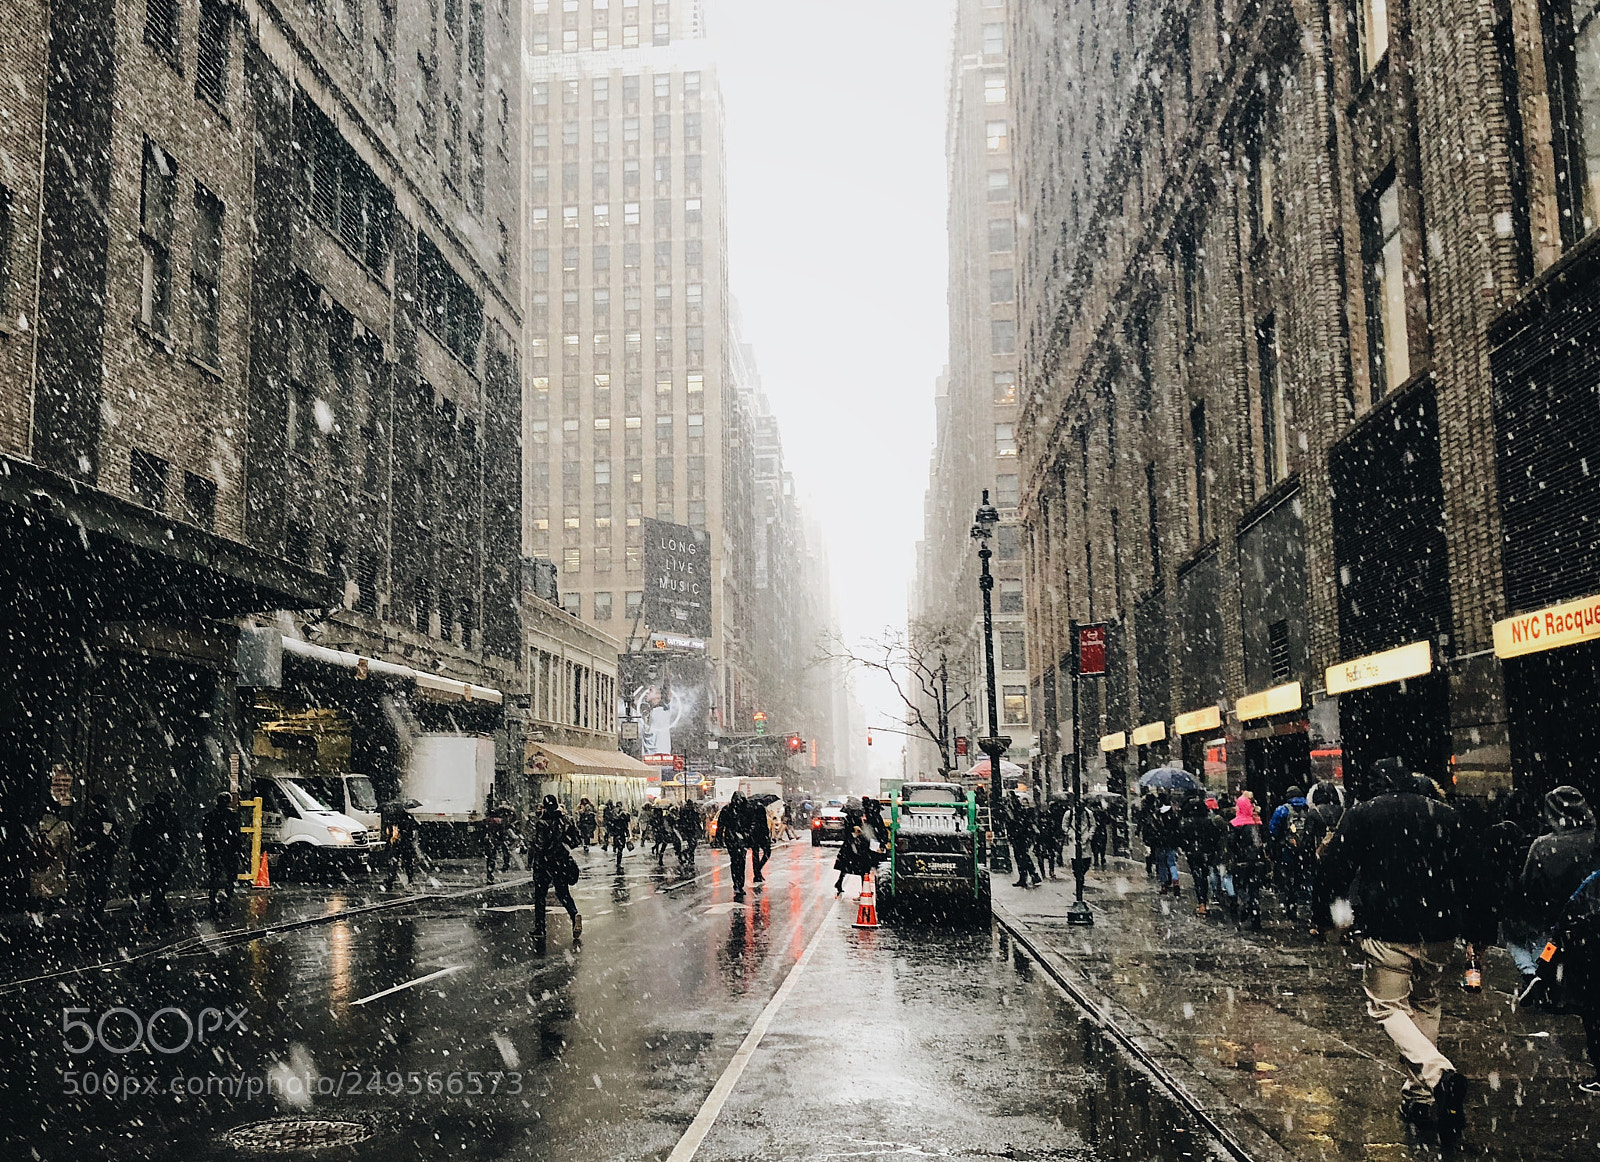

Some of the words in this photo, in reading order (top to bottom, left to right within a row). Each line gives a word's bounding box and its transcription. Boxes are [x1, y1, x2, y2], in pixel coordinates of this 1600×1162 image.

[661, 538, 697, 555] LONG
[666, 559, 693, 574] LIVE
[659, 578, 700, 595] MUSIC
[1511, 616, 1541, 644] NYC
[1544, 605, 1600, 636] Racque
[1345, 664, 1362, 683] Fed
